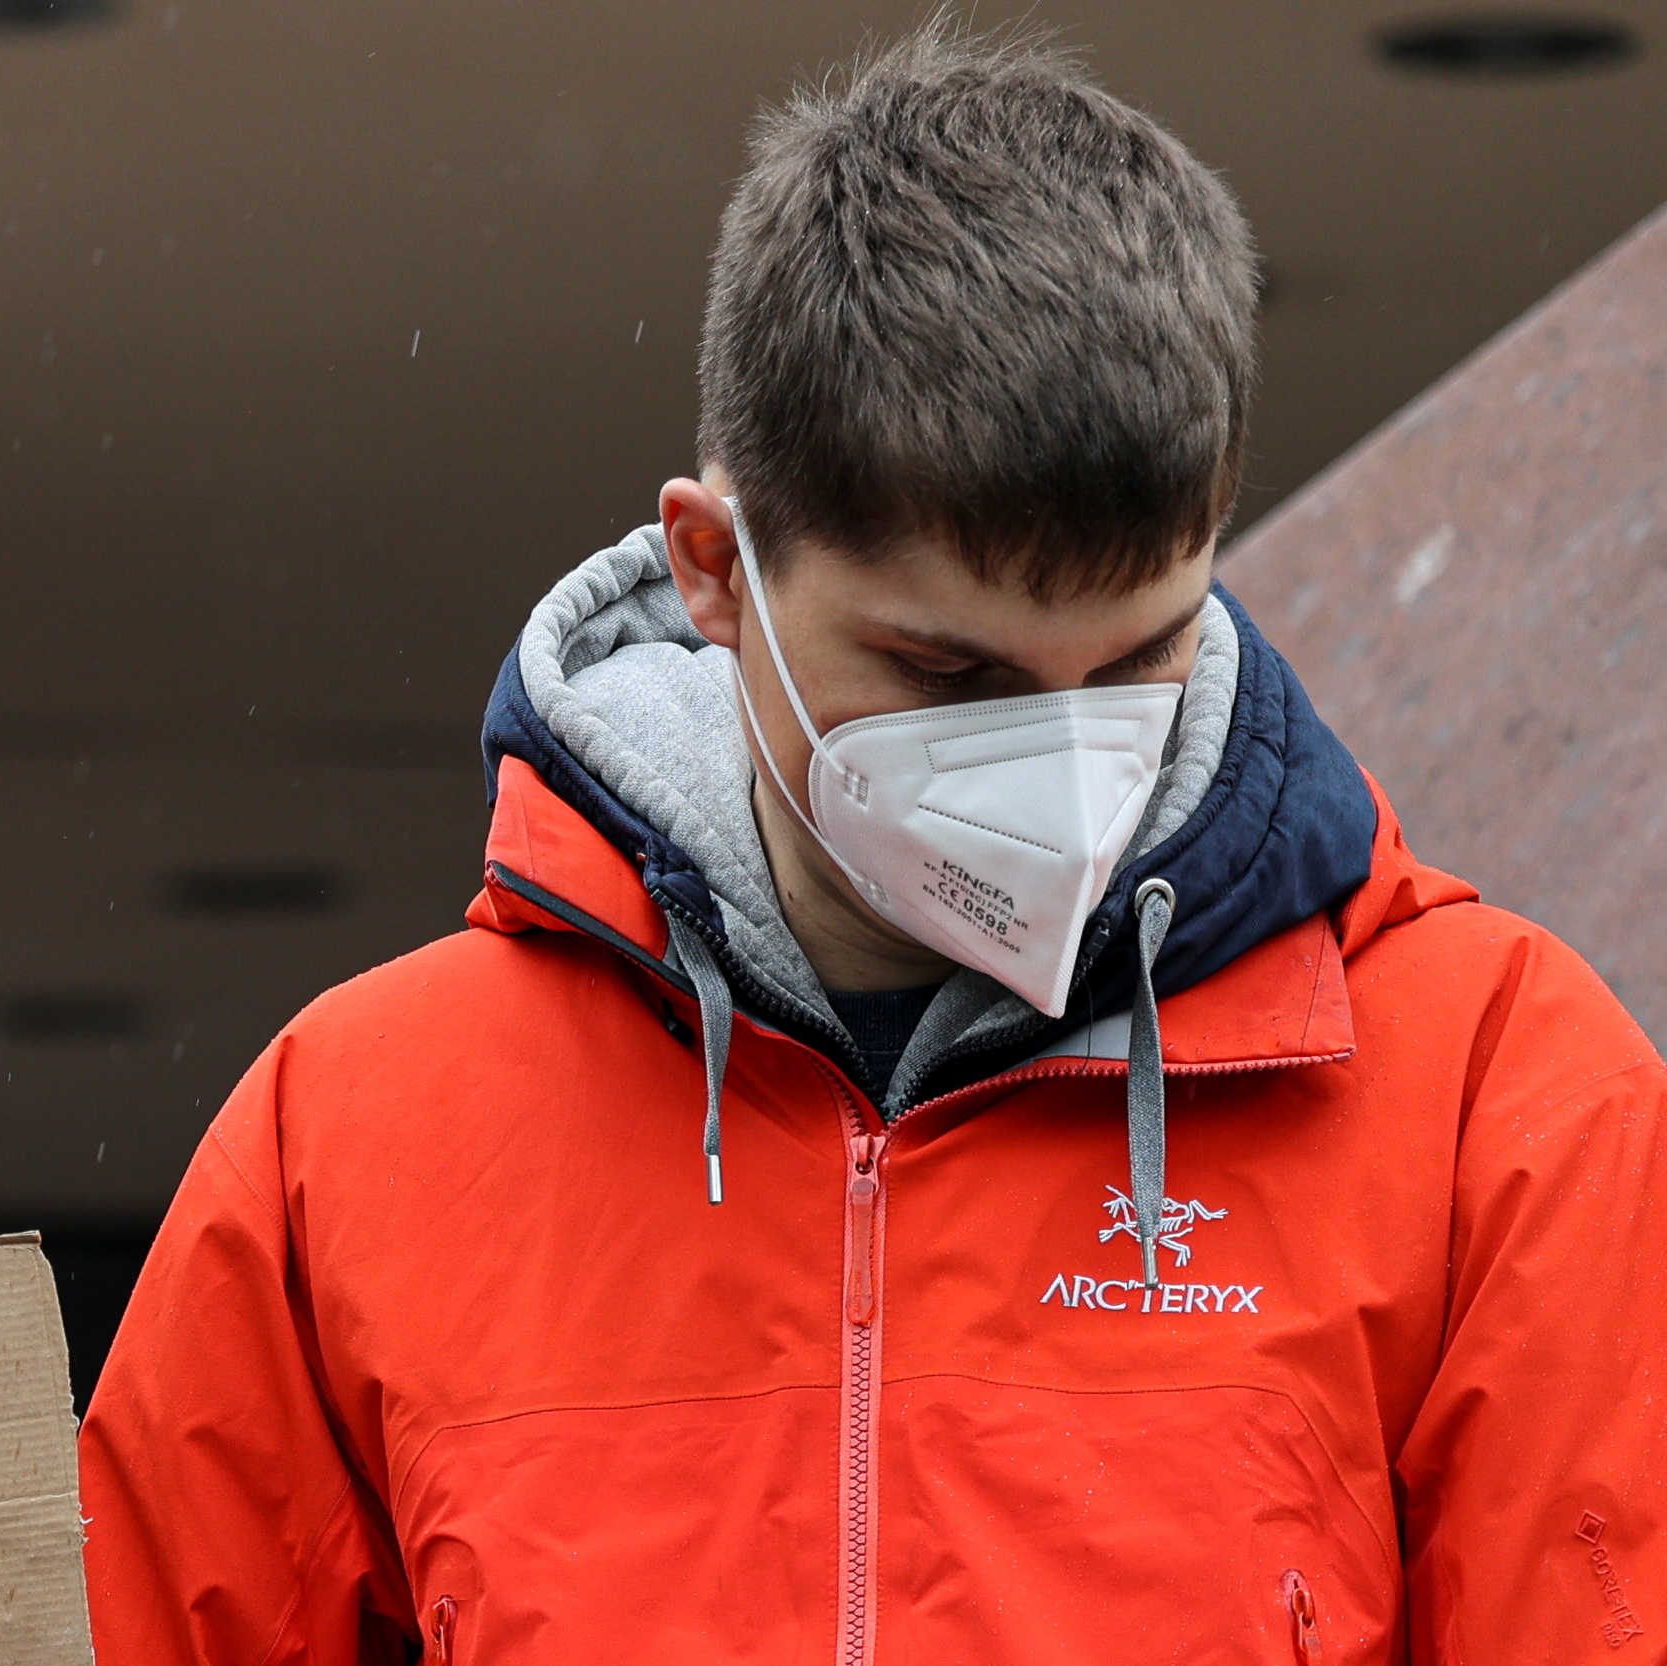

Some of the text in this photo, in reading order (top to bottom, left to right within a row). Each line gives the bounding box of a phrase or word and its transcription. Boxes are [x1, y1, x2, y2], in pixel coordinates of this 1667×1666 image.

[922, 884, 936, 897] EN
[963, 898, 1008, 936] 0598
[987, 901, 1012, 921] FFP2
[1013, 918, 1029, 931] NR
